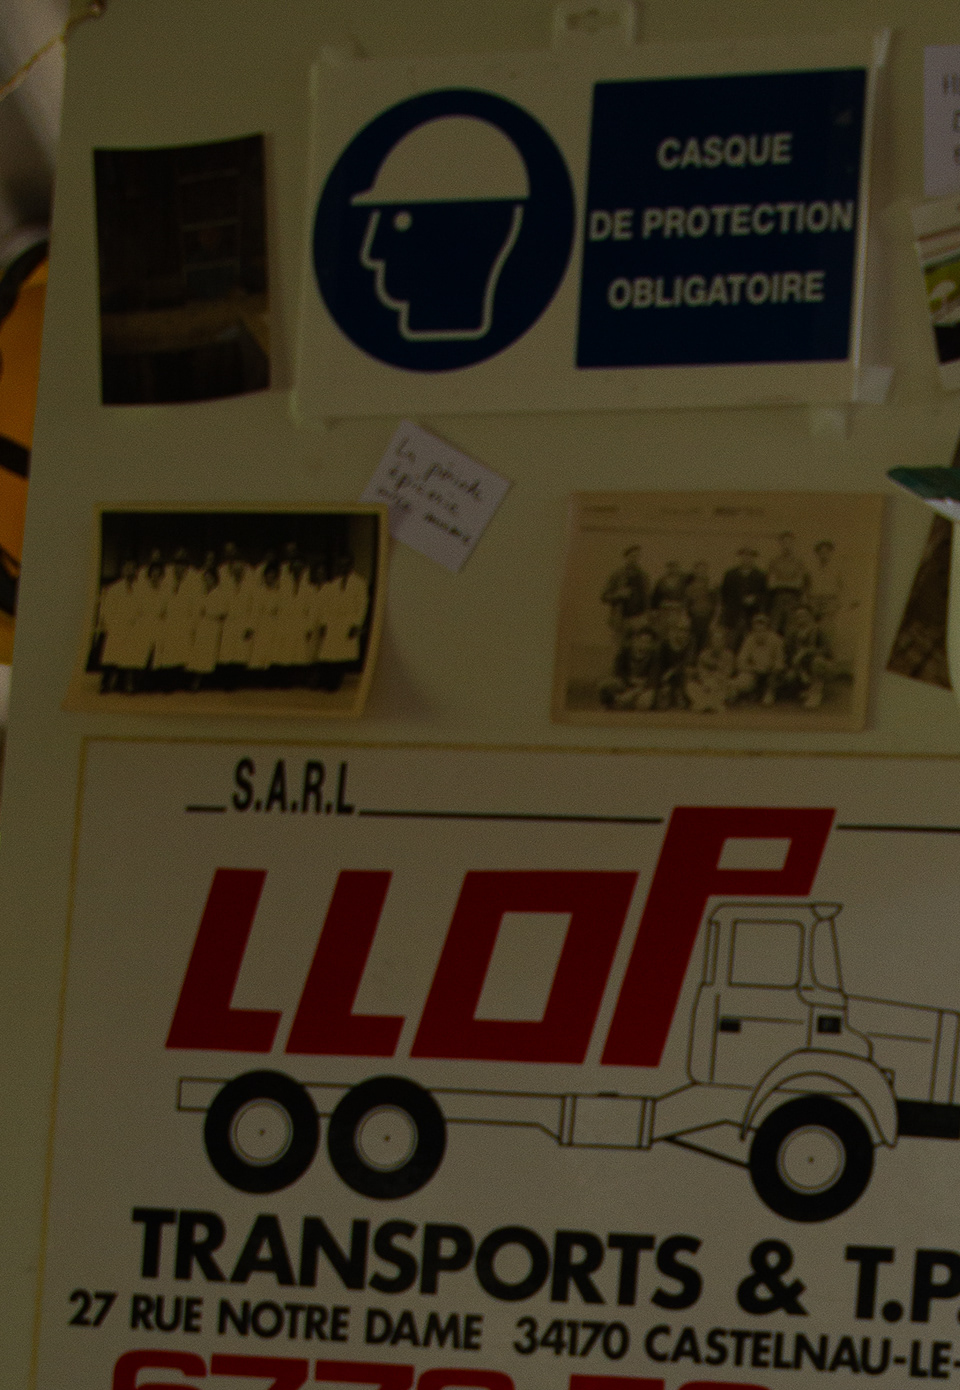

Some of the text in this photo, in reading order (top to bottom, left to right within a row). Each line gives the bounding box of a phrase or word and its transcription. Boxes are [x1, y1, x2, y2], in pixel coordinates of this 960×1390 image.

[657, 132, 793, 170] CASQUE
[589, 201, 854, 241] DE PROTECTION
[608, 271, 825, 309] OBLIGATOIRE
[164, 805, 837, 1068] LLOP
[130, 1206, 704, 1312] TRANSPORTS
[735, 1238, 808, 1317] &
[68, 1290, 117, 1328] 27
[129, 1293, 204, 1334] RUE
[216, 1298, 351, 1343] NOTRE
[364, 1307, 485, 1352] DAME
[513, 1315, 630, 1361] 34170
